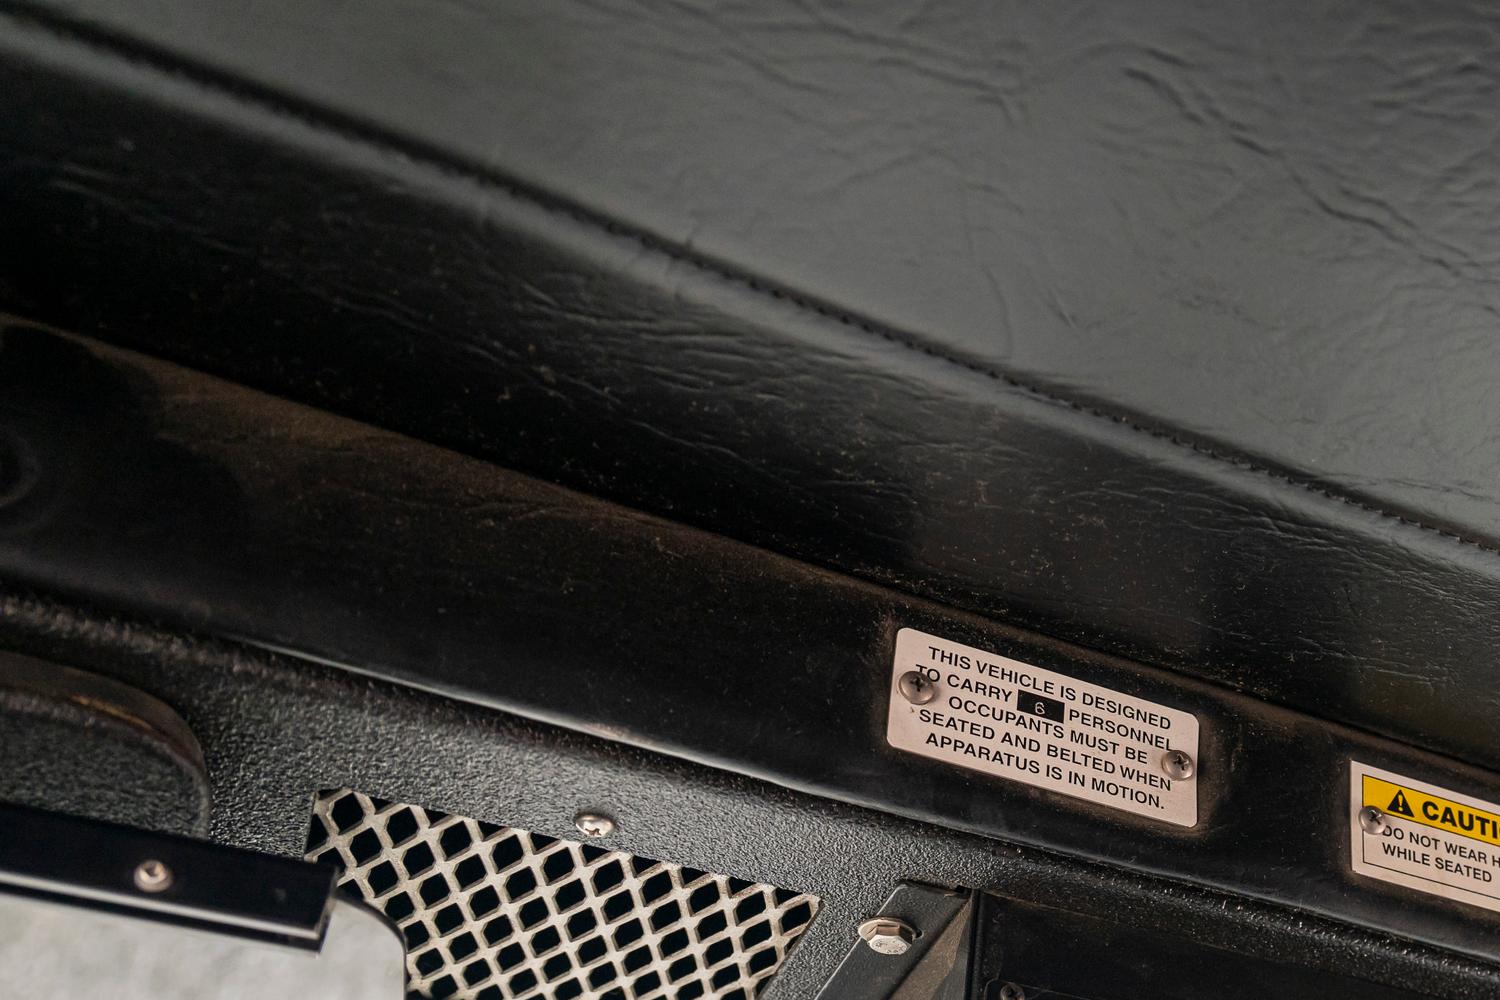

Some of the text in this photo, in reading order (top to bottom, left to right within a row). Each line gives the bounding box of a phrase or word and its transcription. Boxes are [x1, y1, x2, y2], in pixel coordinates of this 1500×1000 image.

[915, 664, 1172, 751] TO CARRY 6 PERSONNEL
[928, 646, 1171, 730] THIS VEHICLE IS DESIGNED
[919, 709, 1172, 791] SEATED AND BELTED WHEN
[948, 696, 1148, 764] OCCUPANTS MUST BE
[926, 733, 1165, 809] APPARATUS IS IN MOTION.
[1382, 825, 1404, 840] DO
[1409, 831, 1441, 851] NOT
[1445, 843, 1487, 864] WEAR
[1382, 842, 1492, 883] WHILE SEATED
